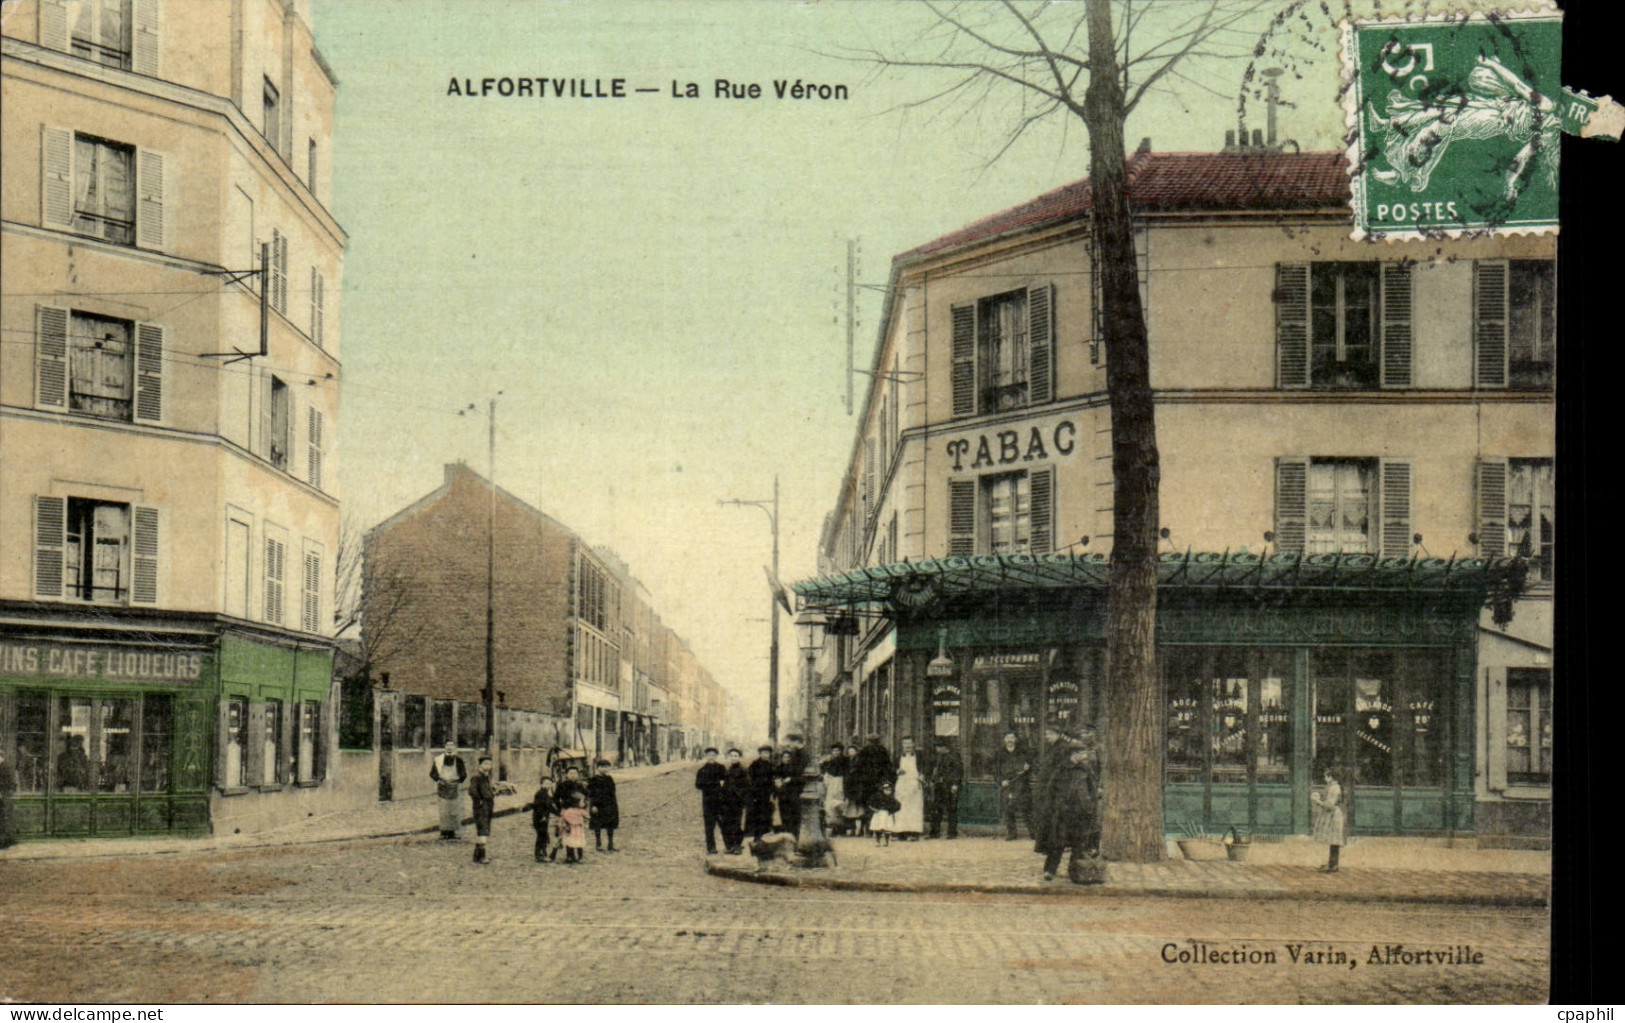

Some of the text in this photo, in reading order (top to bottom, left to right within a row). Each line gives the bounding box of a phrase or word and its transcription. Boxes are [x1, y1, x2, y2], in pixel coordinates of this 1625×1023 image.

[1377, 201, 1457, 222] POSTES
[946, 420, 1076, 472] TABAC
[0, 645, 38, 671] INS
[106, 650, 201, 679] LIQUEURS
